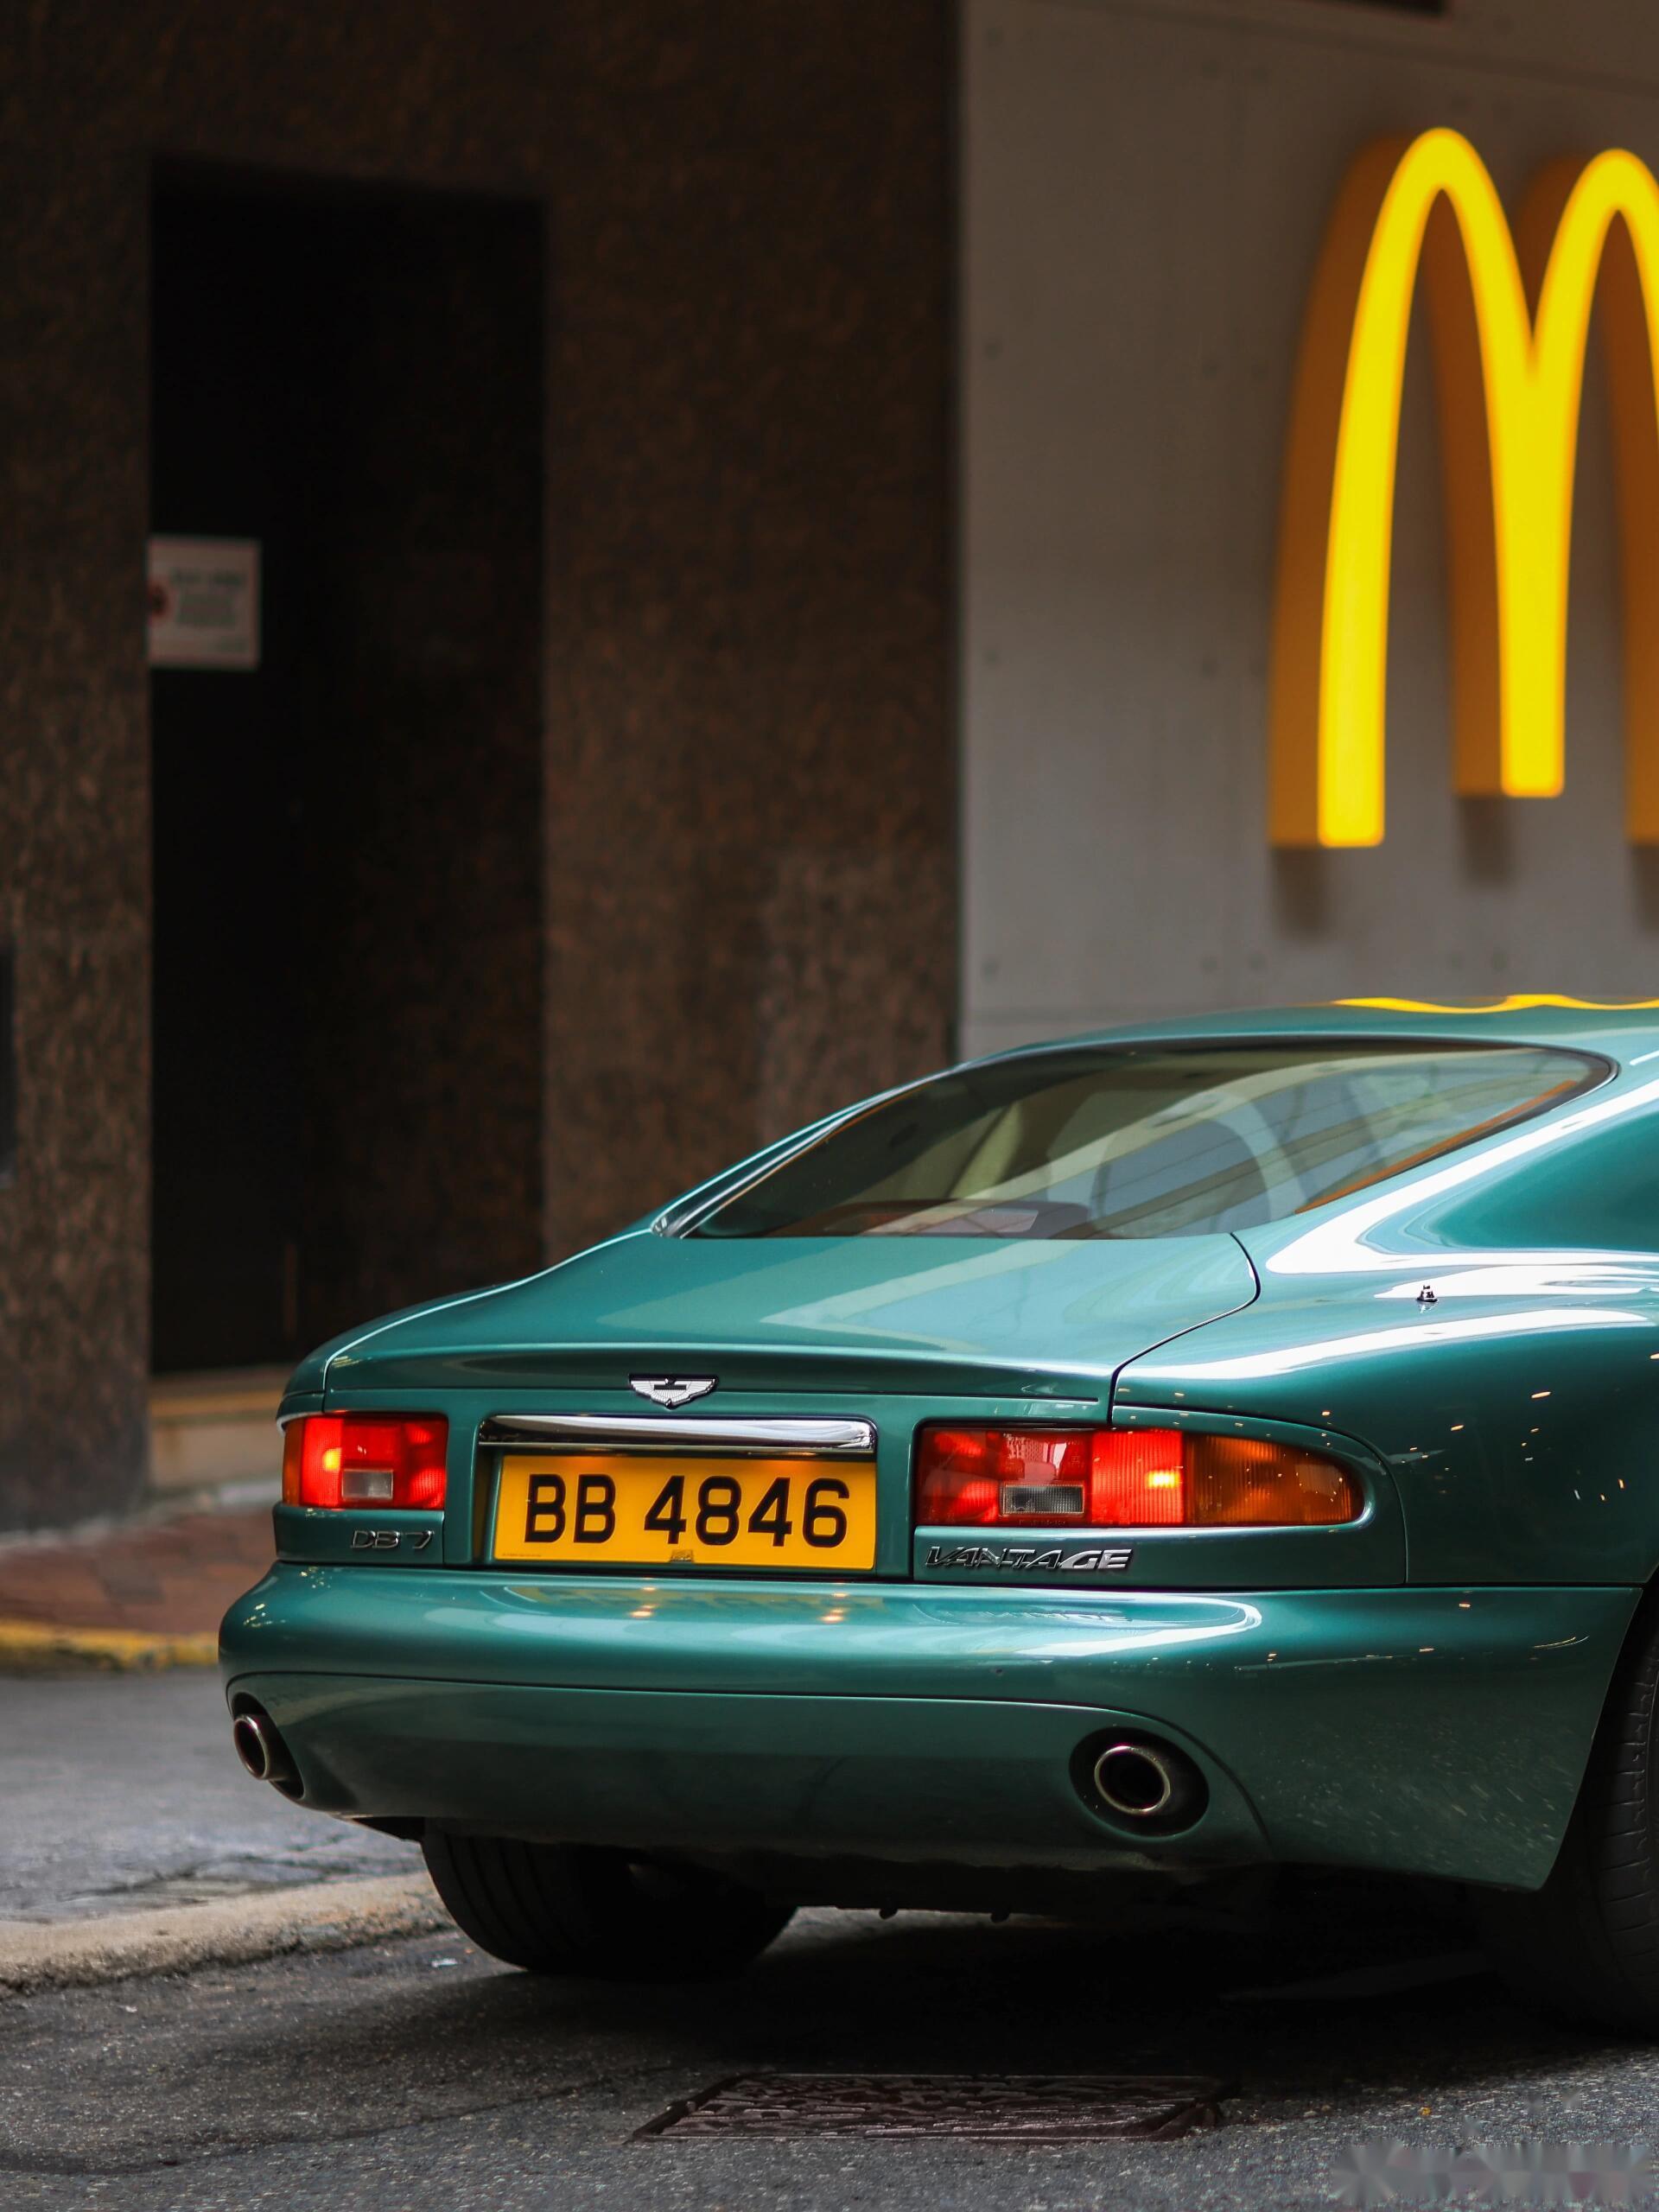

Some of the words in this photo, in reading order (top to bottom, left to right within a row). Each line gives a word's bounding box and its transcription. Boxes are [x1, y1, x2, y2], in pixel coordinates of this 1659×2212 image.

[524, 1473, 616, 1543] BB
[644, 1475, 850, 1548] 4846
[925, 1546, 1134, 1570] VANTAGE
